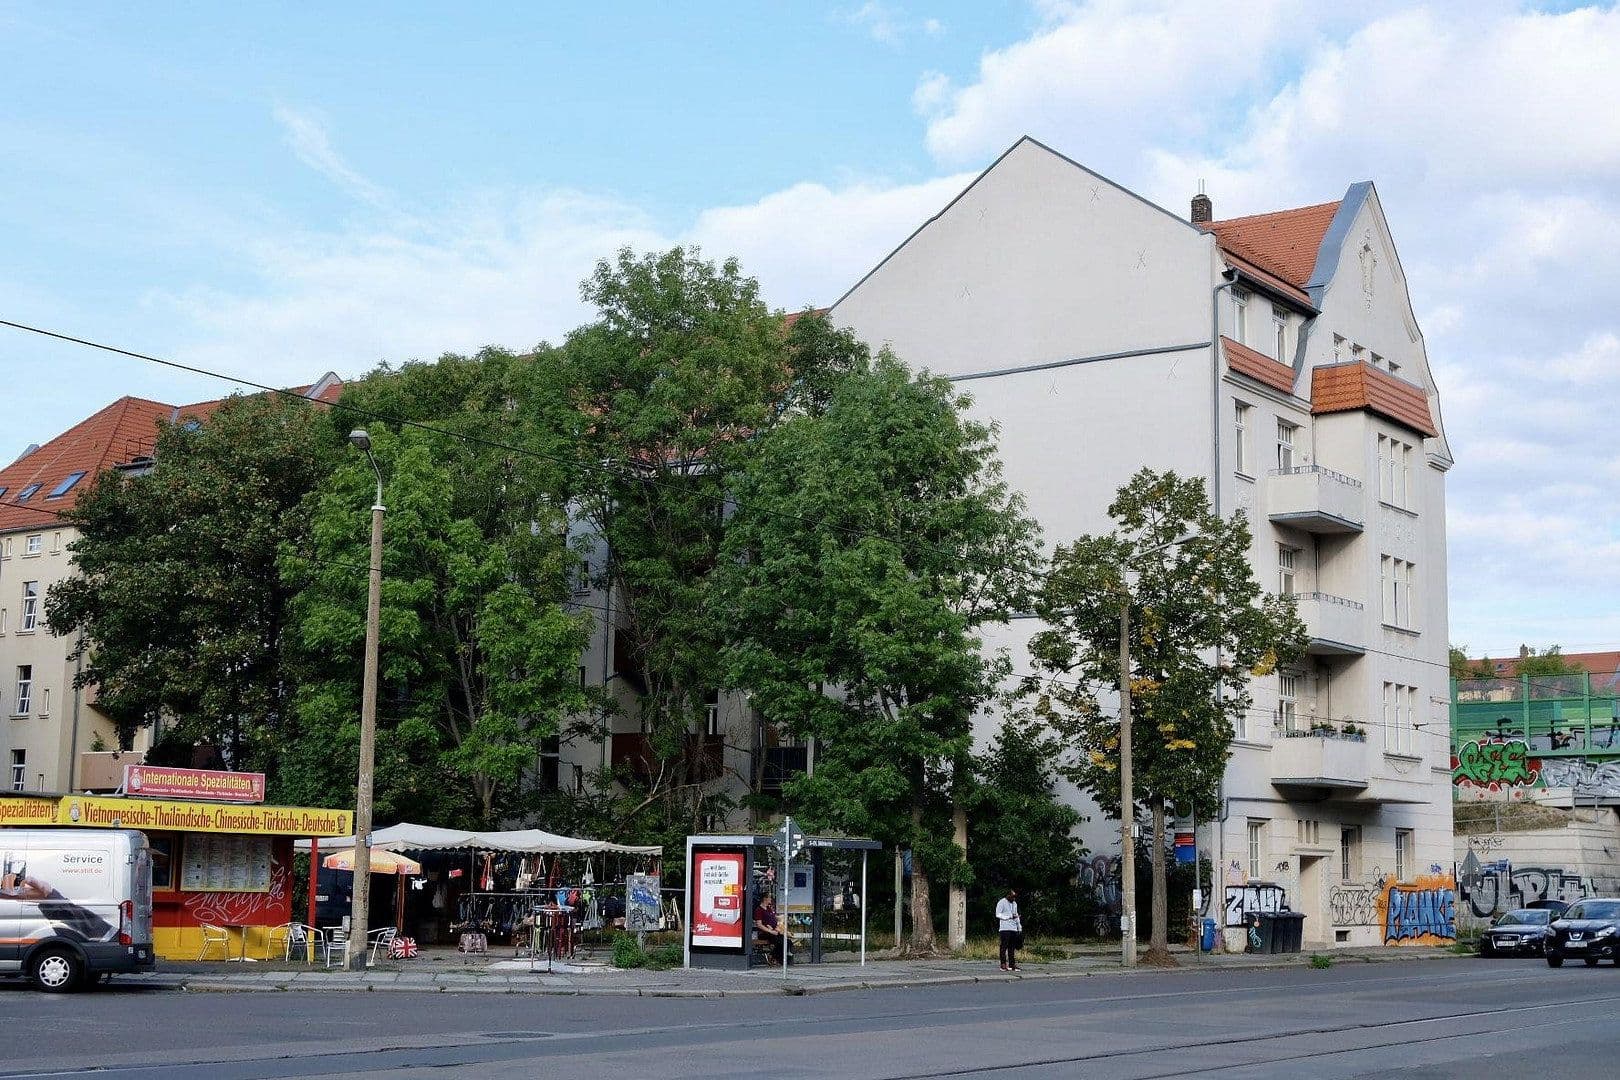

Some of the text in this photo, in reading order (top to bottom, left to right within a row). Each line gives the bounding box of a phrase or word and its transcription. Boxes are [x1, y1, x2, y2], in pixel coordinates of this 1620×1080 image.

[143, 770, 251, 790] Internationale Spezialitäten
[63, 854, 103, 864] Service
